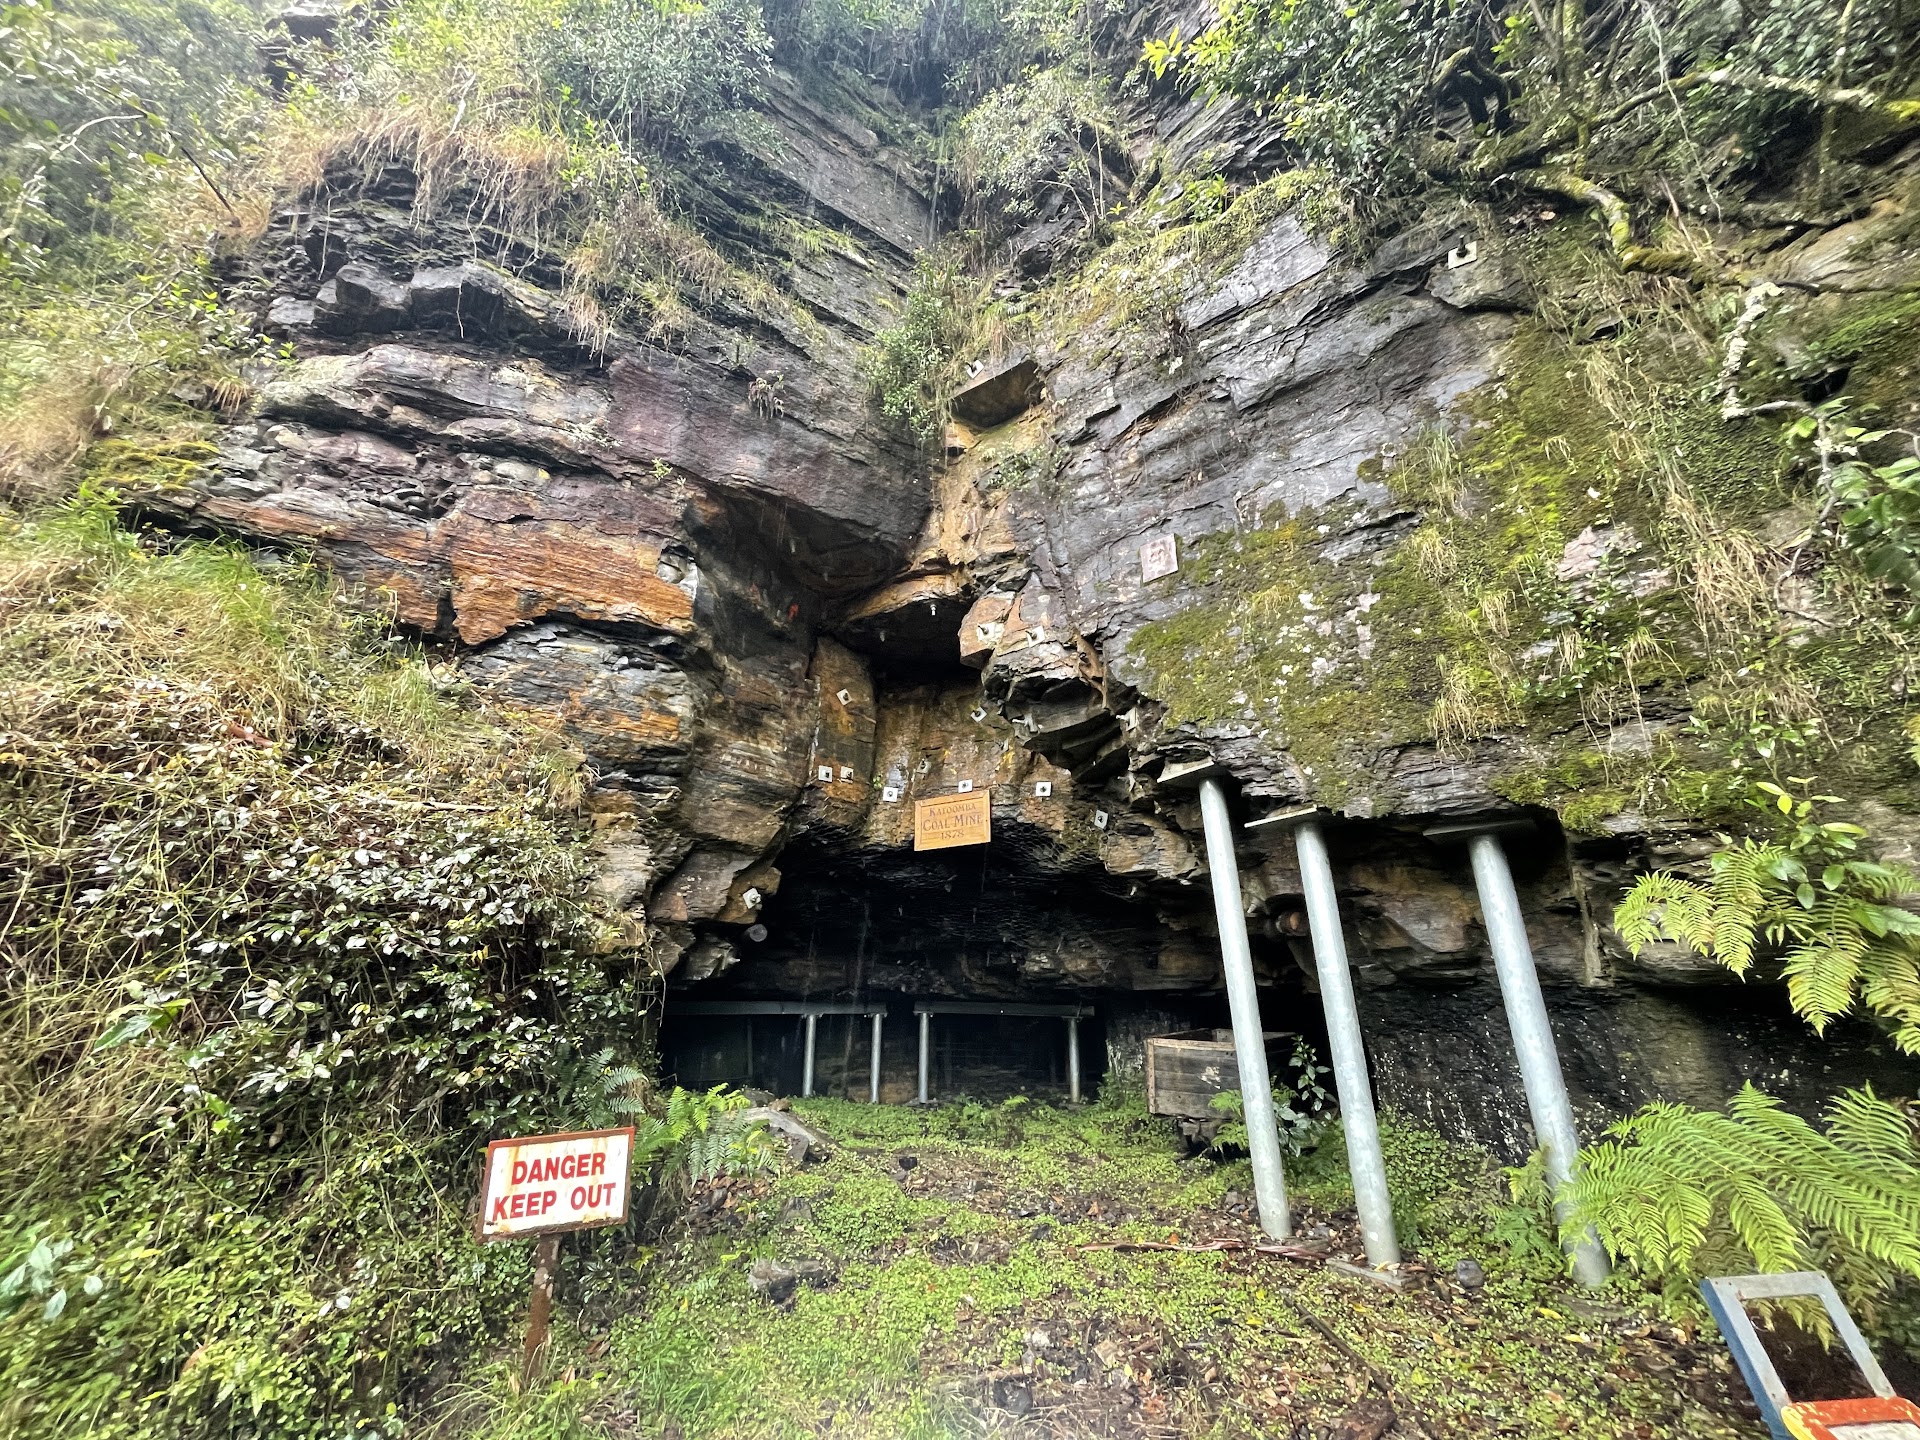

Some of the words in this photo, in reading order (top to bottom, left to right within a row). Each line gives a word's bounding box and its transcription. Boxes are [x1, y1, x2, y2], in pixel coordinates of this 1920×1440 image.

[922, 819, 951, 831] COAL
[953, 814, 983, 828] MINE
[941, 829, 965, 840] 1878
[511, 1152, 606, 1186] DANGER
[492, 1190, 557, 1222] KEEP
[570, 1182, 616, 1211] OUT
